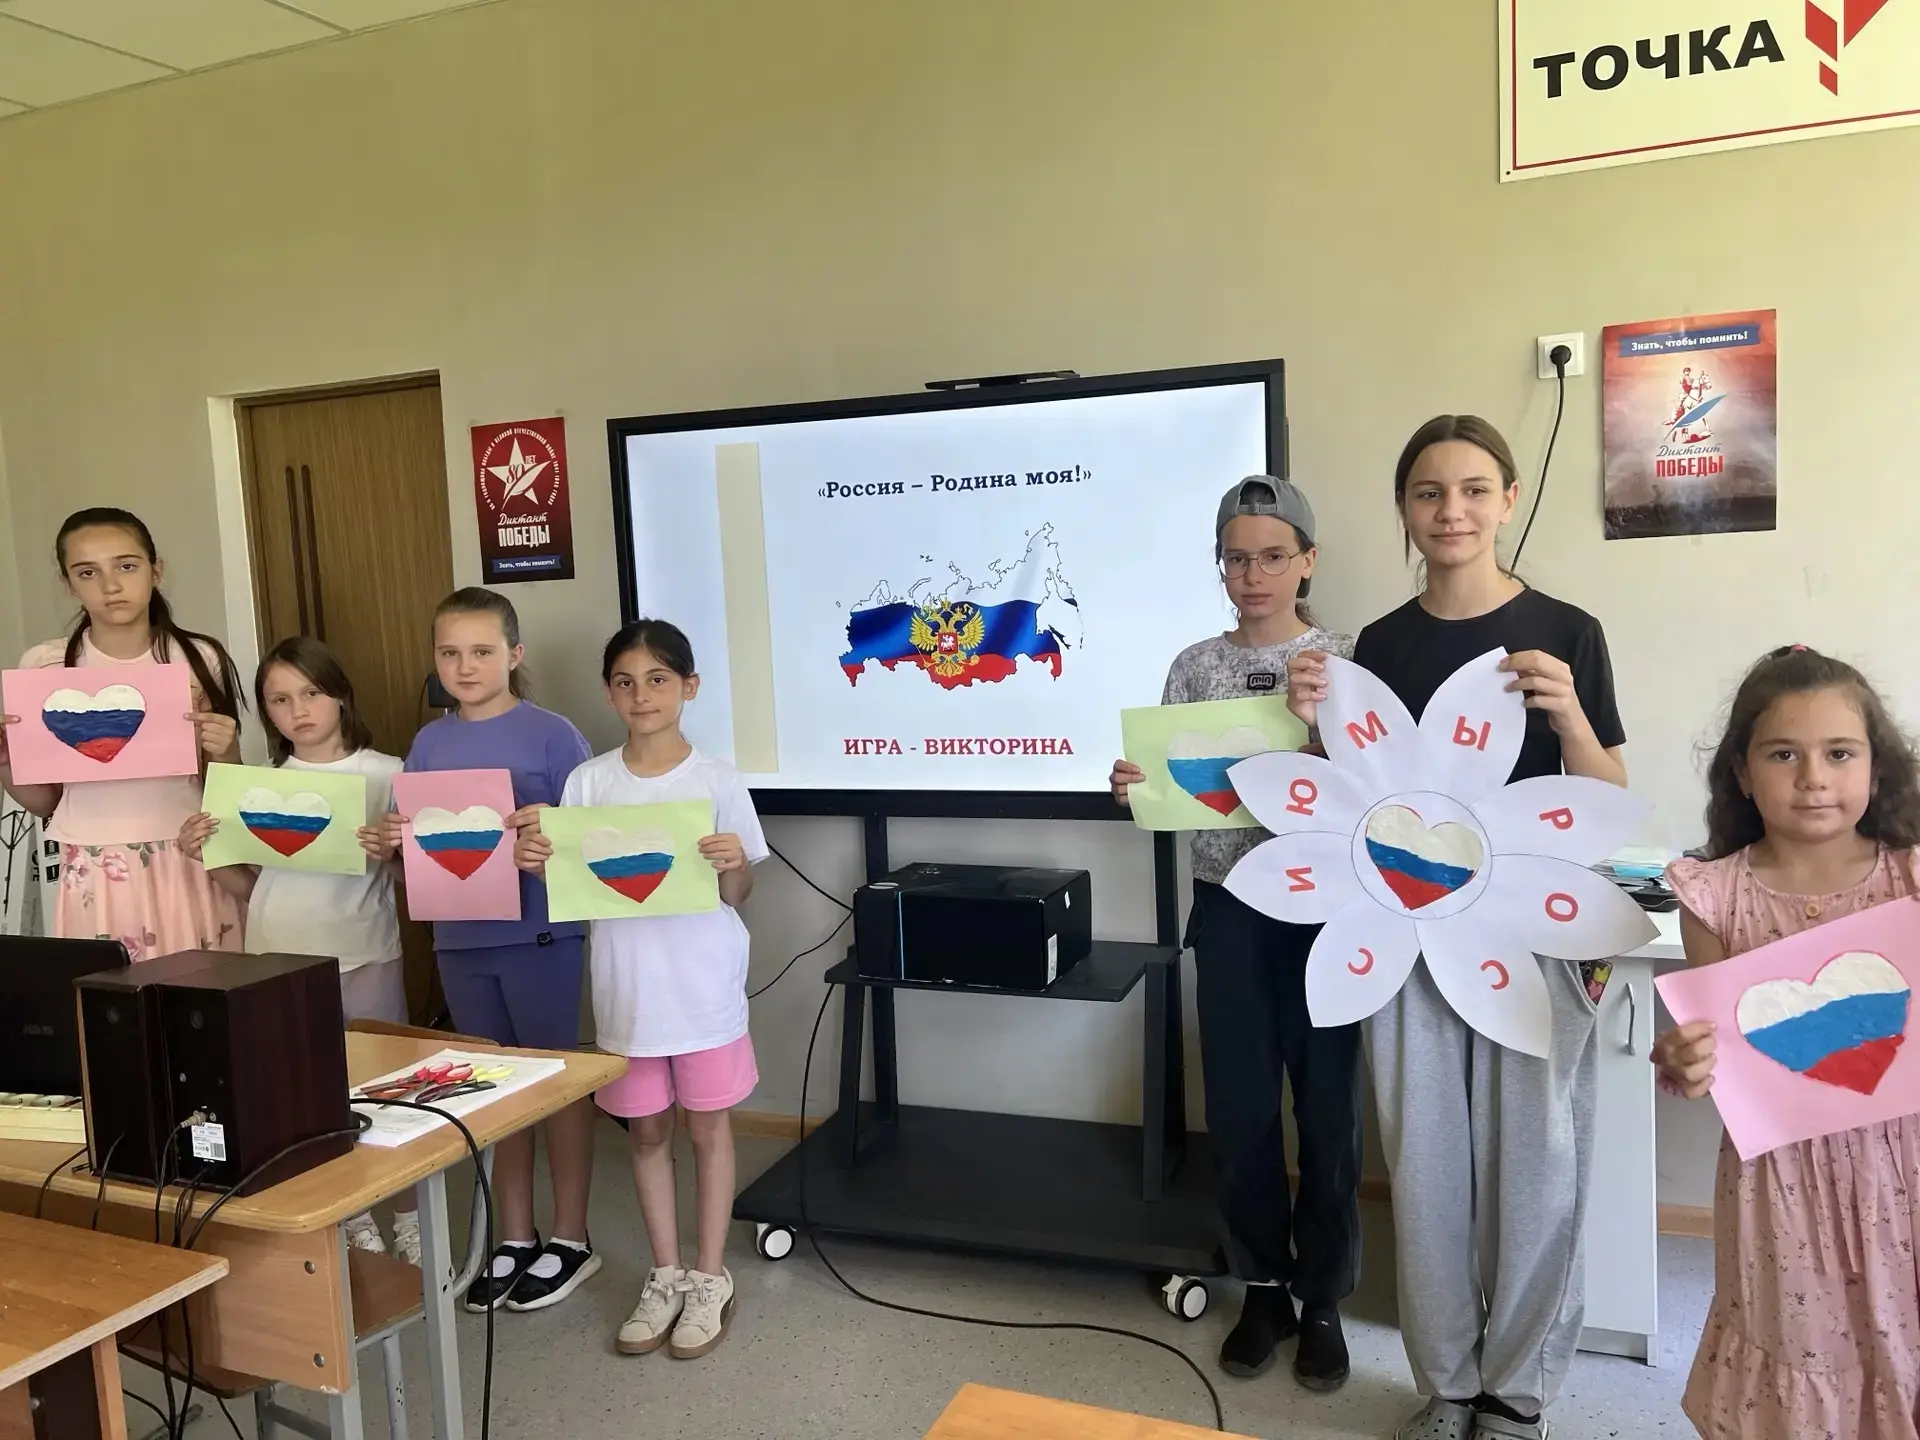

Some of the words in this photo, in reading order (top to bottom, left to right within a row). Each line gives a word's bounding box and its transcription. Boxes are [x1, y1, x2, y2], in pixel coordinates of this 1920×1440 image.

[1533, 19, 1785, 99] ТОЧКА
[1631, 341, 1663, 351] Знать,
[1665, 337, 1697, 348] чтобы
[1699, 330, 1748, 345] помнить!
[1656, 443, 1722, 458] Диктант
[1656, 455, 1724, 478] ПОБЕДЫ
[818, 481, 905, 498] «Россия
[930, 471, 1017, 492] Родина
[1025, 465, 1092, 486] моя!»
[497, 512, 548, 526] Диктант
[497, 524, 551, 548] ПОБЕДЫ
[843, 738, 903, 755] ИГРА
[924, 738, 1074, 755] ВИКТОРИНА
